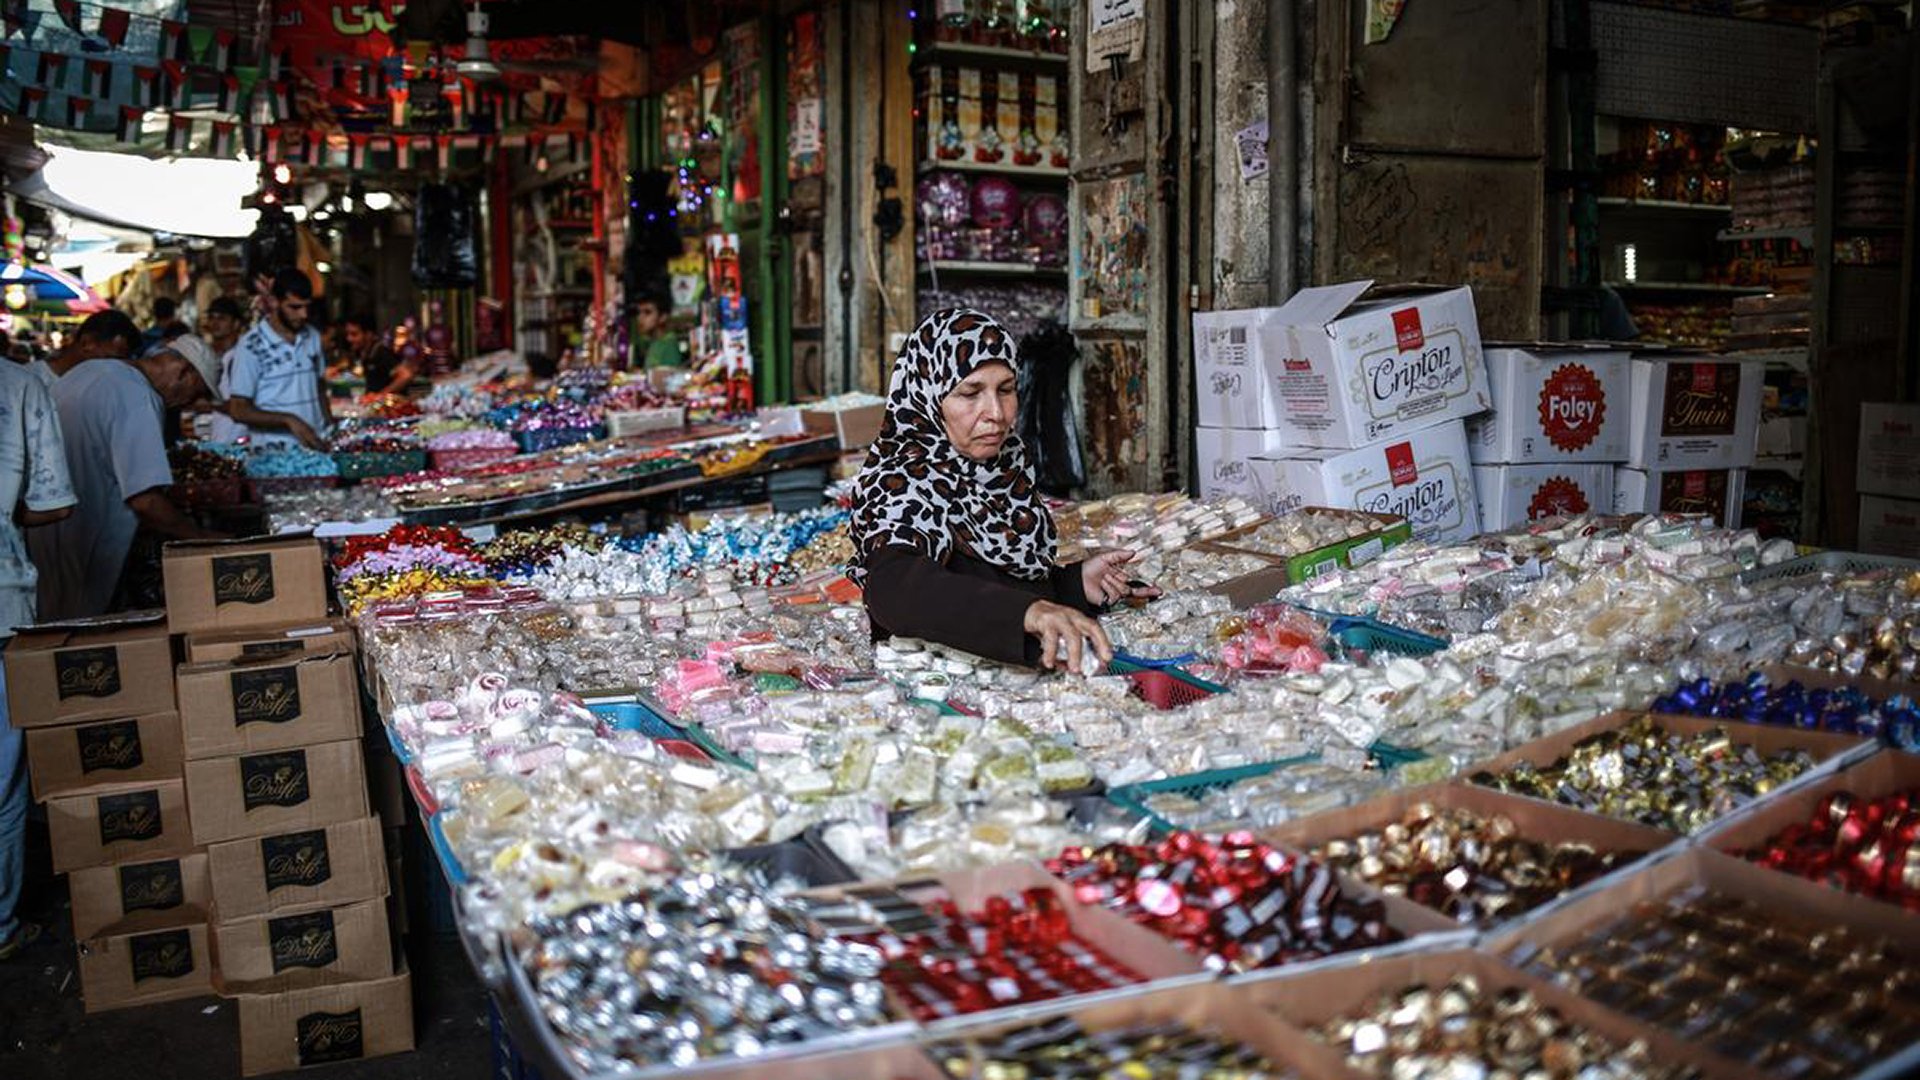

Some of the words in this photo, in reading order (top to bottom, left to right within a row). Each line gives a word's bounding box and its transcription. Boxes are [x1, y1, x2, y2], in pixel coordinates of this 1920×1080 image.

[1368, 346, 1451, 400] Cripton
[1550, 395, 1597, 423] Foley
[1669, 391, 1728, 427] Twin
